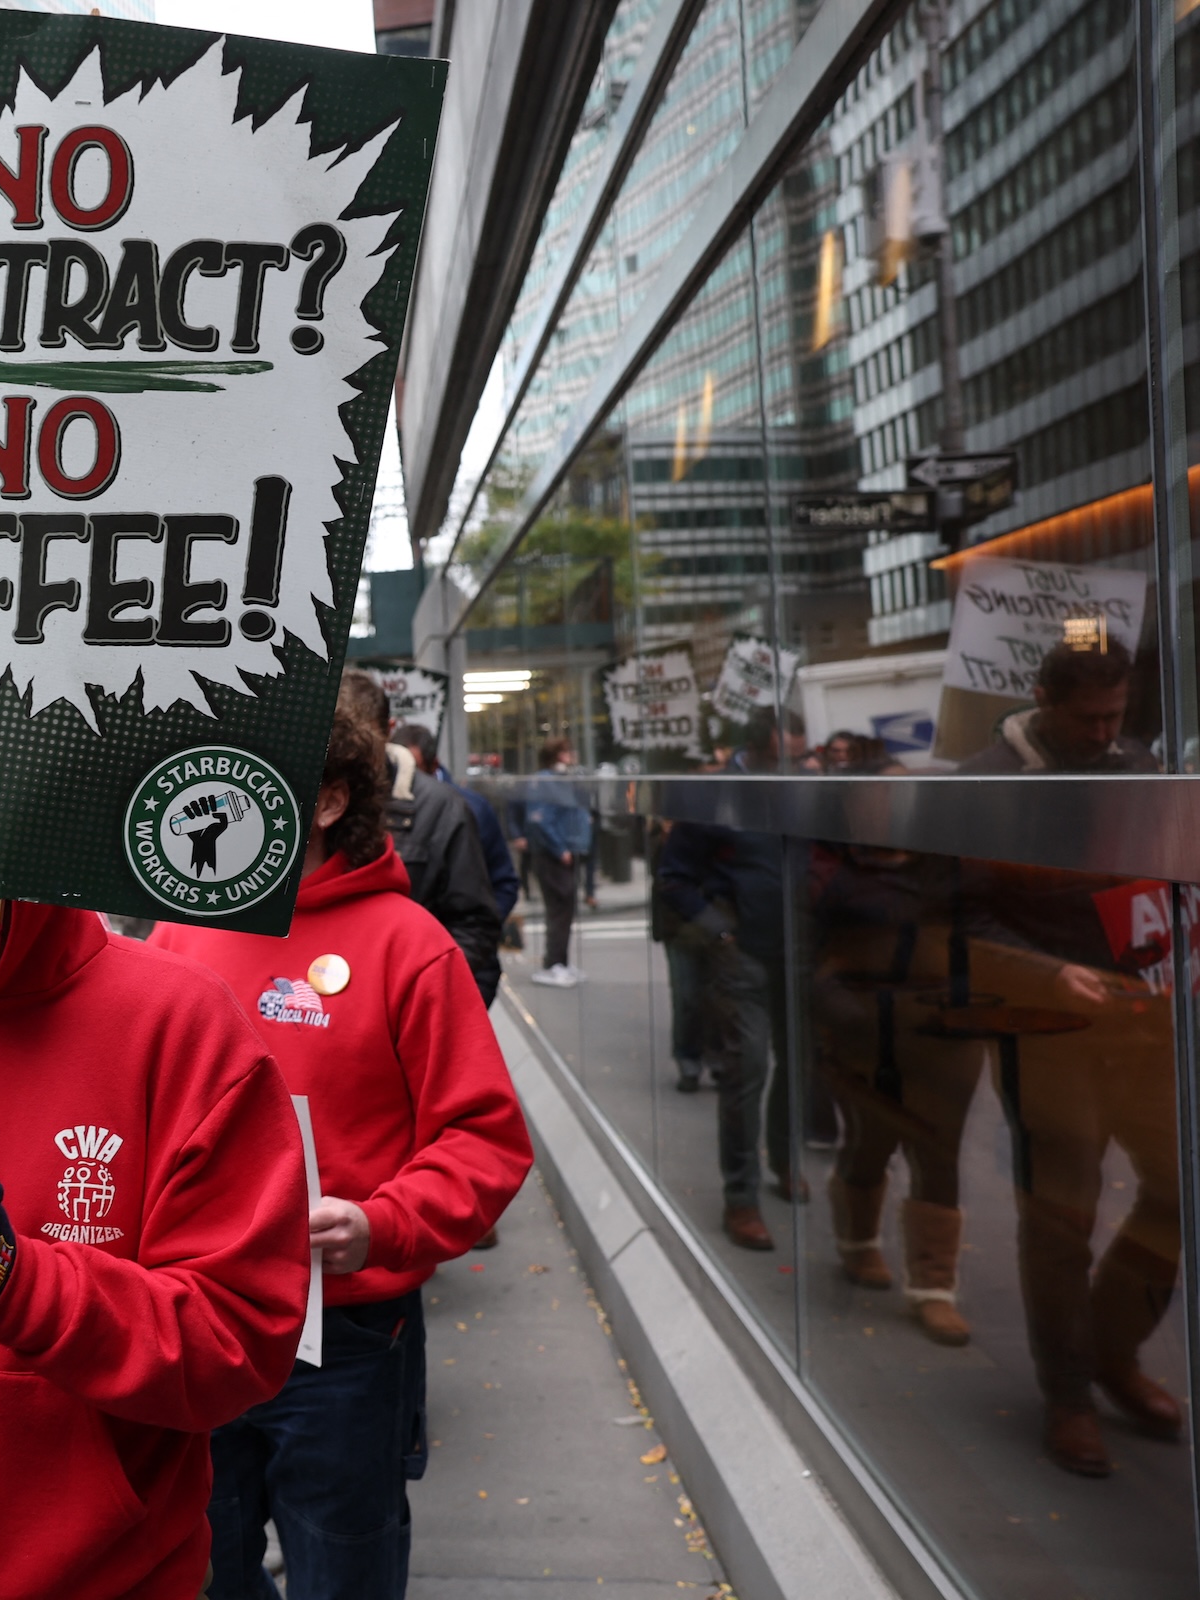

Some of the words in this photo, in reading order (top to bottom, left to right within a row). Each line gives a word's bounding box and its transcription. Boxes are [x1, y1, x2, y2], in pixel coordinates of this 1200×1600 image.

[157, 757, 285, 811] STARBUCKS
[135, 820, 201, 904] WORKERS
[225, 838, 287, 901] UNITED
[276, 1008, 303, 1023] LOCAL
[303, 1010, 331, 1029] 1104
[54, 1125, 124, 1164] CWA
[40, 1222, 125, 1244] ORGANIZER
